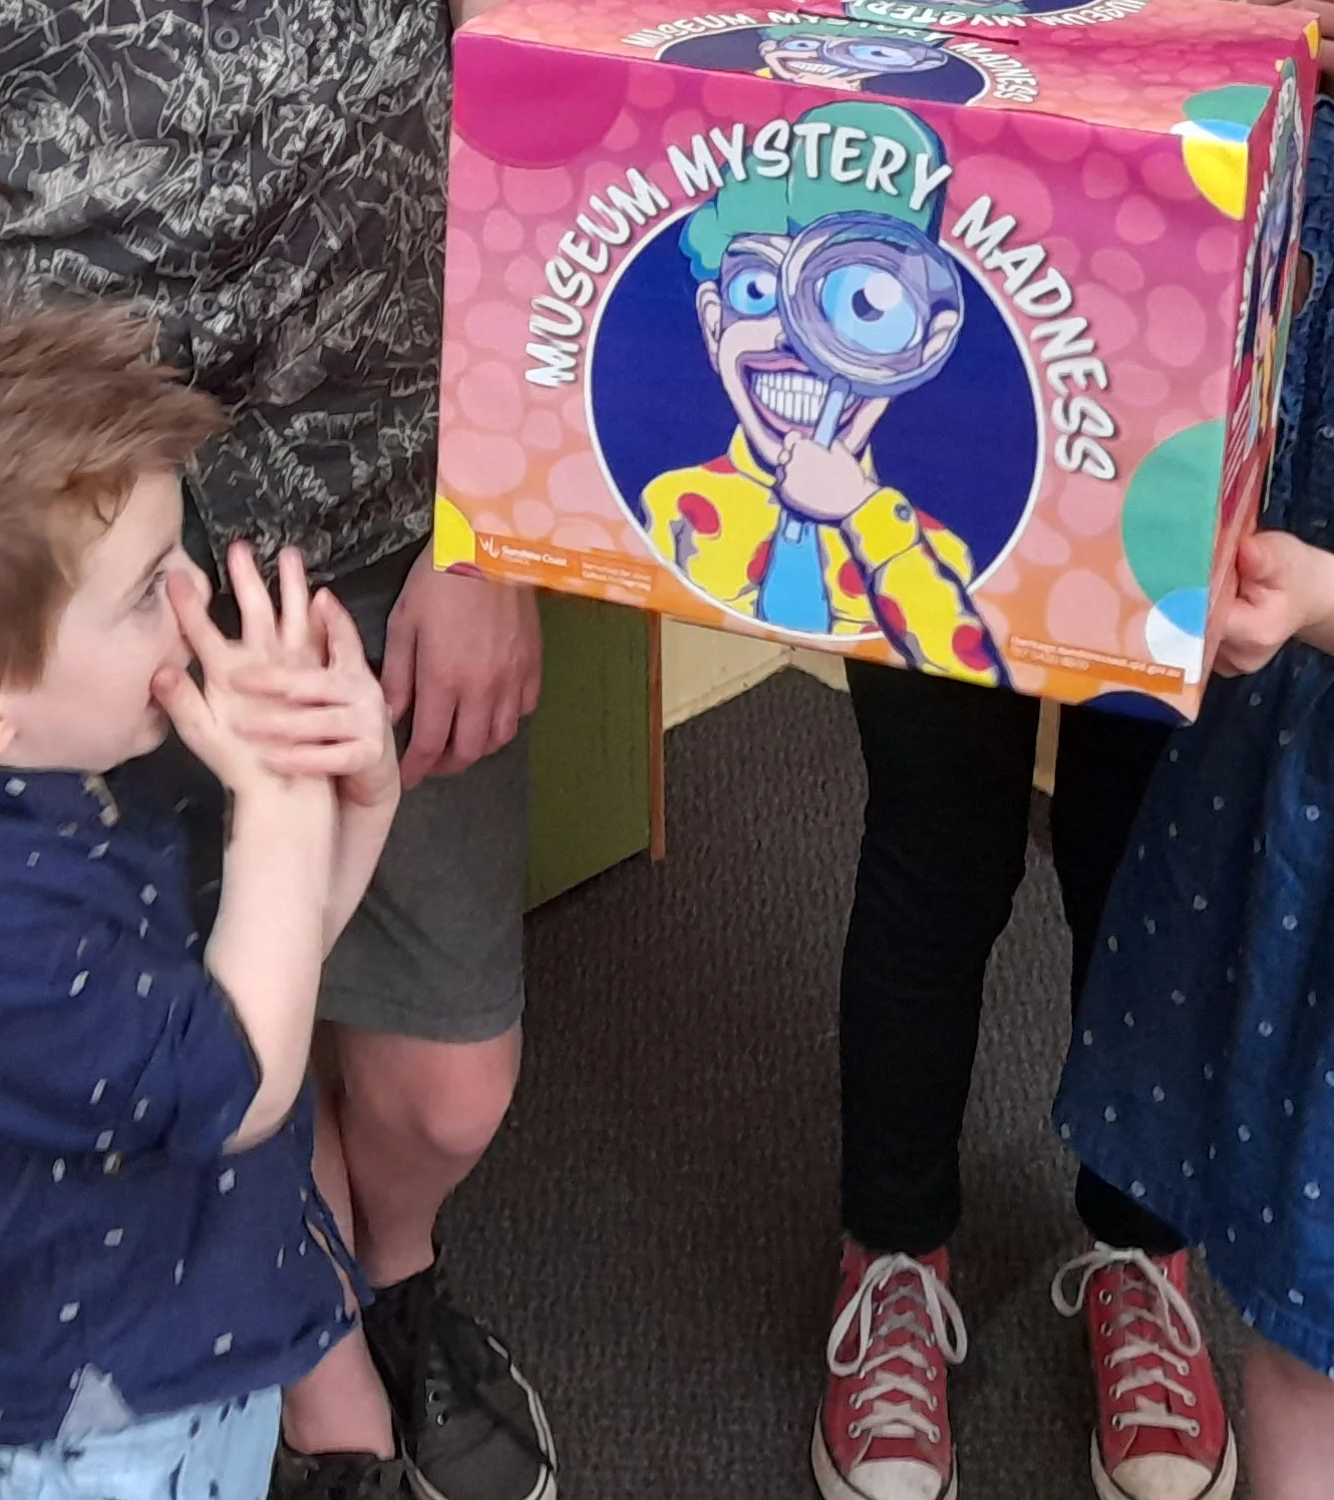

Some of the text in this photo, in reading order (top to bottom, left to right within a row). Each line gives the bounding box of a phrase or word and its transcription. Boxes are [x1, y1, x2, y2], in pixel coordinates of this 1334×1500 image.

[620, 12, 756, 49] MUSEUM
[952, 41, 1041, 103] MADNESS
[525, 119, 1118, 481] MUSEUM MYSTERY MADNESS
